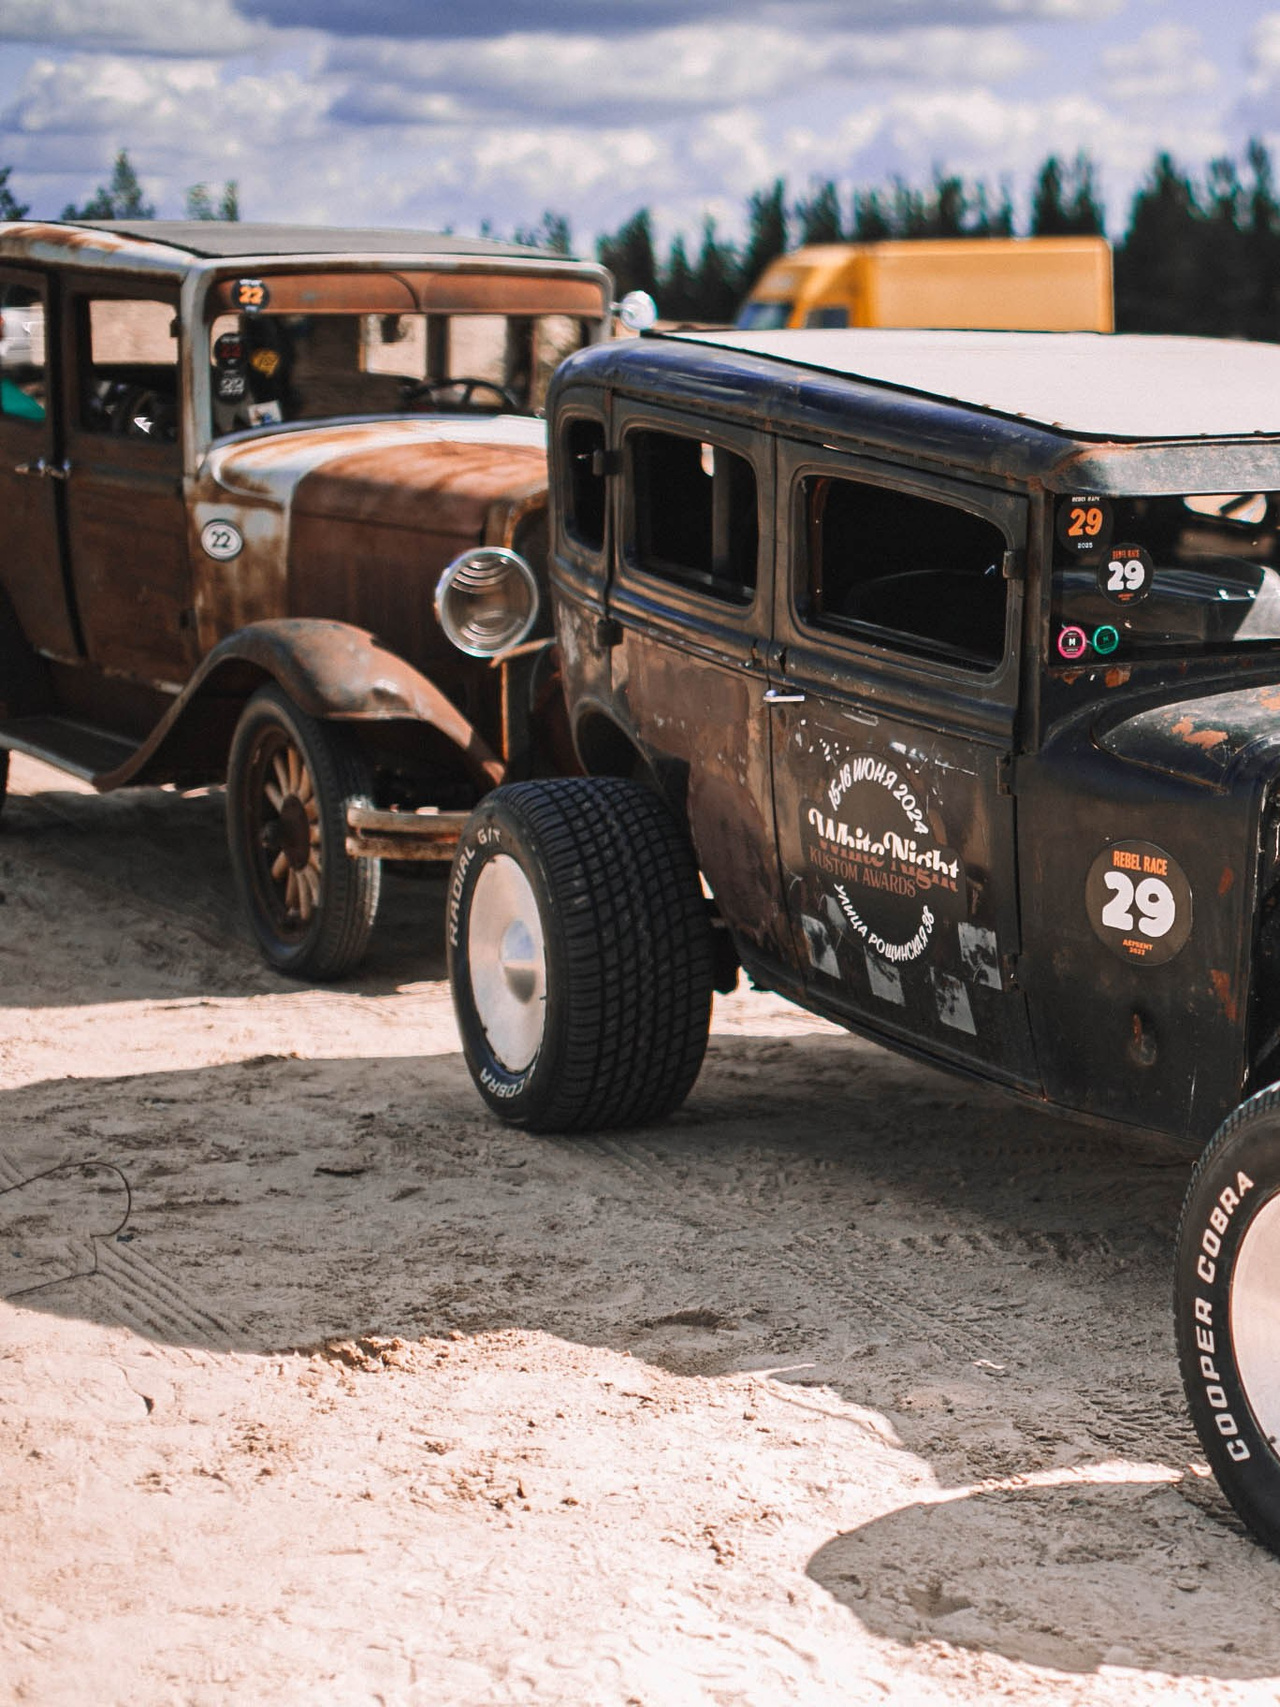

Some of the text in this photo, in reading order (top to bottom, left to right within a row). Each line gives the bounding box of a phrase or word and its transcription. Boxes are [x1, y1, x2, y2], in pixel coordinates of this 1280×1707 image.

[238, 286, 264, 305] 22
[211, 531, 231, 548] 22
[1068, 507, 1103, 536] 29
[1107, 560, 1145, 591] 29
[828, 757, 929, 834] 15-16 ИЮНЯ 2024
[808, 807, 959, 892] White Night
[810, 845, 916, 898] KUSTOM AWARDS
[1113, 850, 1168, 876] REBEL RACE
[449, 846, 475, 947] RADIAL
[833, 883, 868, 938] УЛИЦА
[868, 925, 928, 963] РОЩИНСКАЯ
[1102, 871, 1176, 938] 29
[480, 1068, 526, 1098] COBRA
[1195, 1170, 1254, 1462] COOPER COBRA
